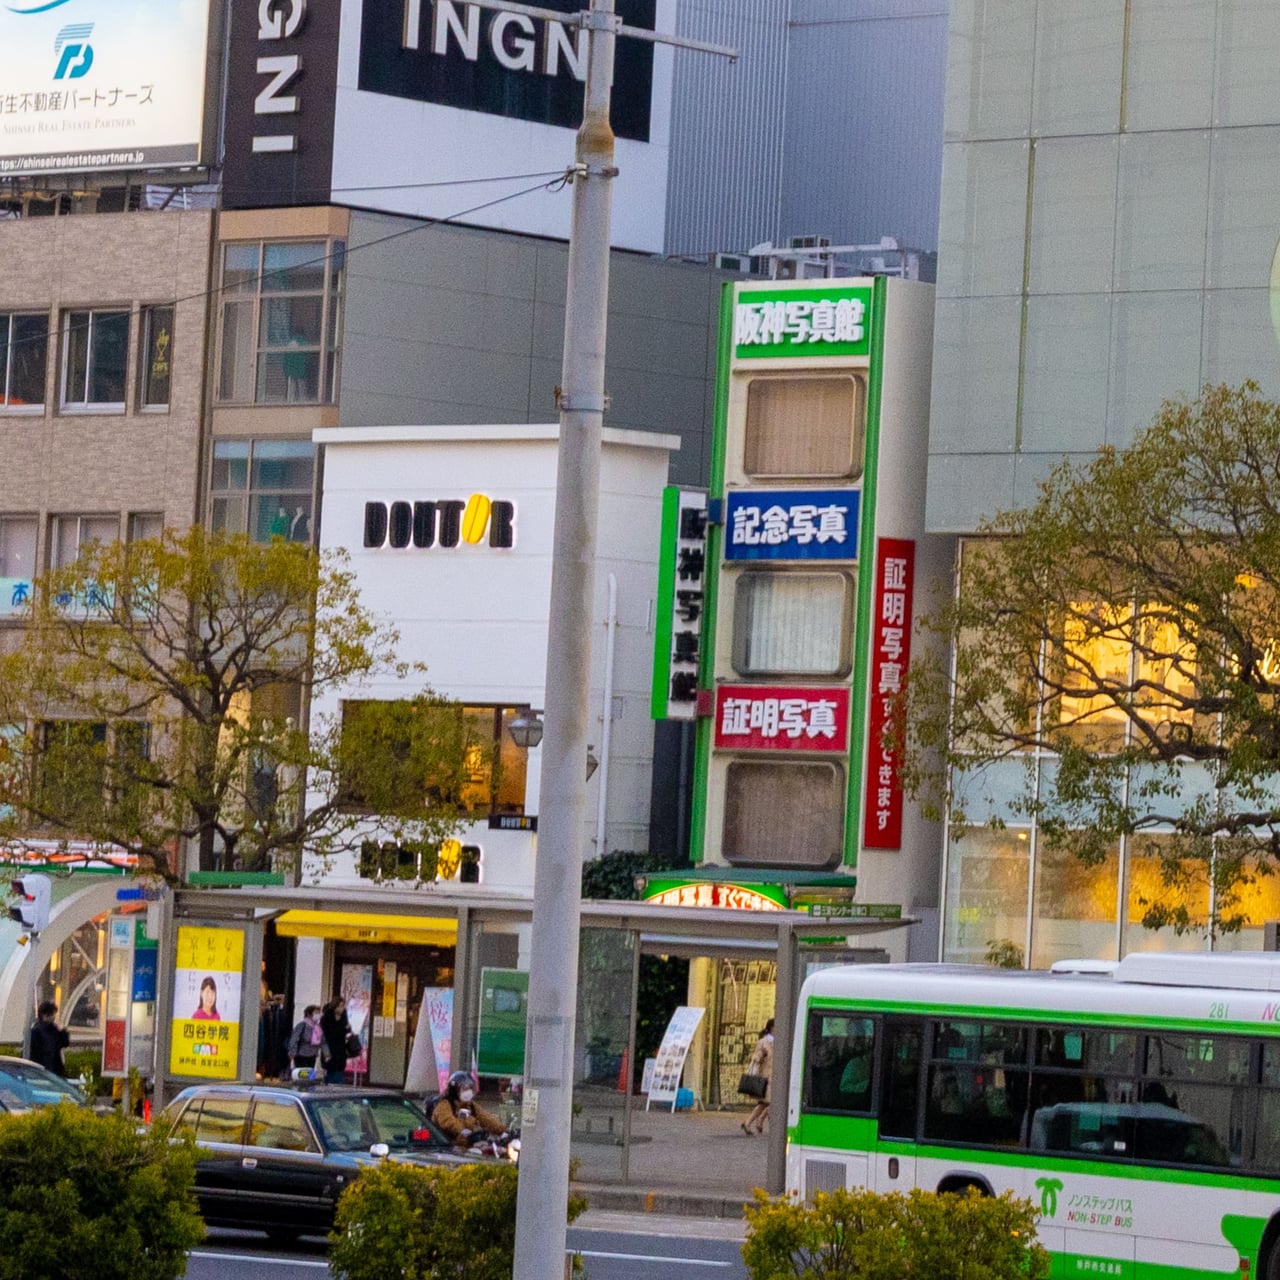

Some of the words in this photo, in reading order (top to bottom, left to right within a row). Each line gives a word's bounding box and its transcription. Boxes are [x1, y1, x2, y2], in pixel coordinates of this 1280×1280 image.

[0, 150, 144, 169] tps://shinseirealestatepartners.jp
[736, 298, 864, 345] 阪神写真館
[363, 493, 514, 549] DOUTOR
[732, 505, 847, 545] 記念写真
[722, 698, 837, 739] 証明写真
[1209, 1002, 1230, 1019] 281
[183, 1023, 230, 1041] 四谷学院
[1068, 1194, 1132, 1213] ノンステップバス
